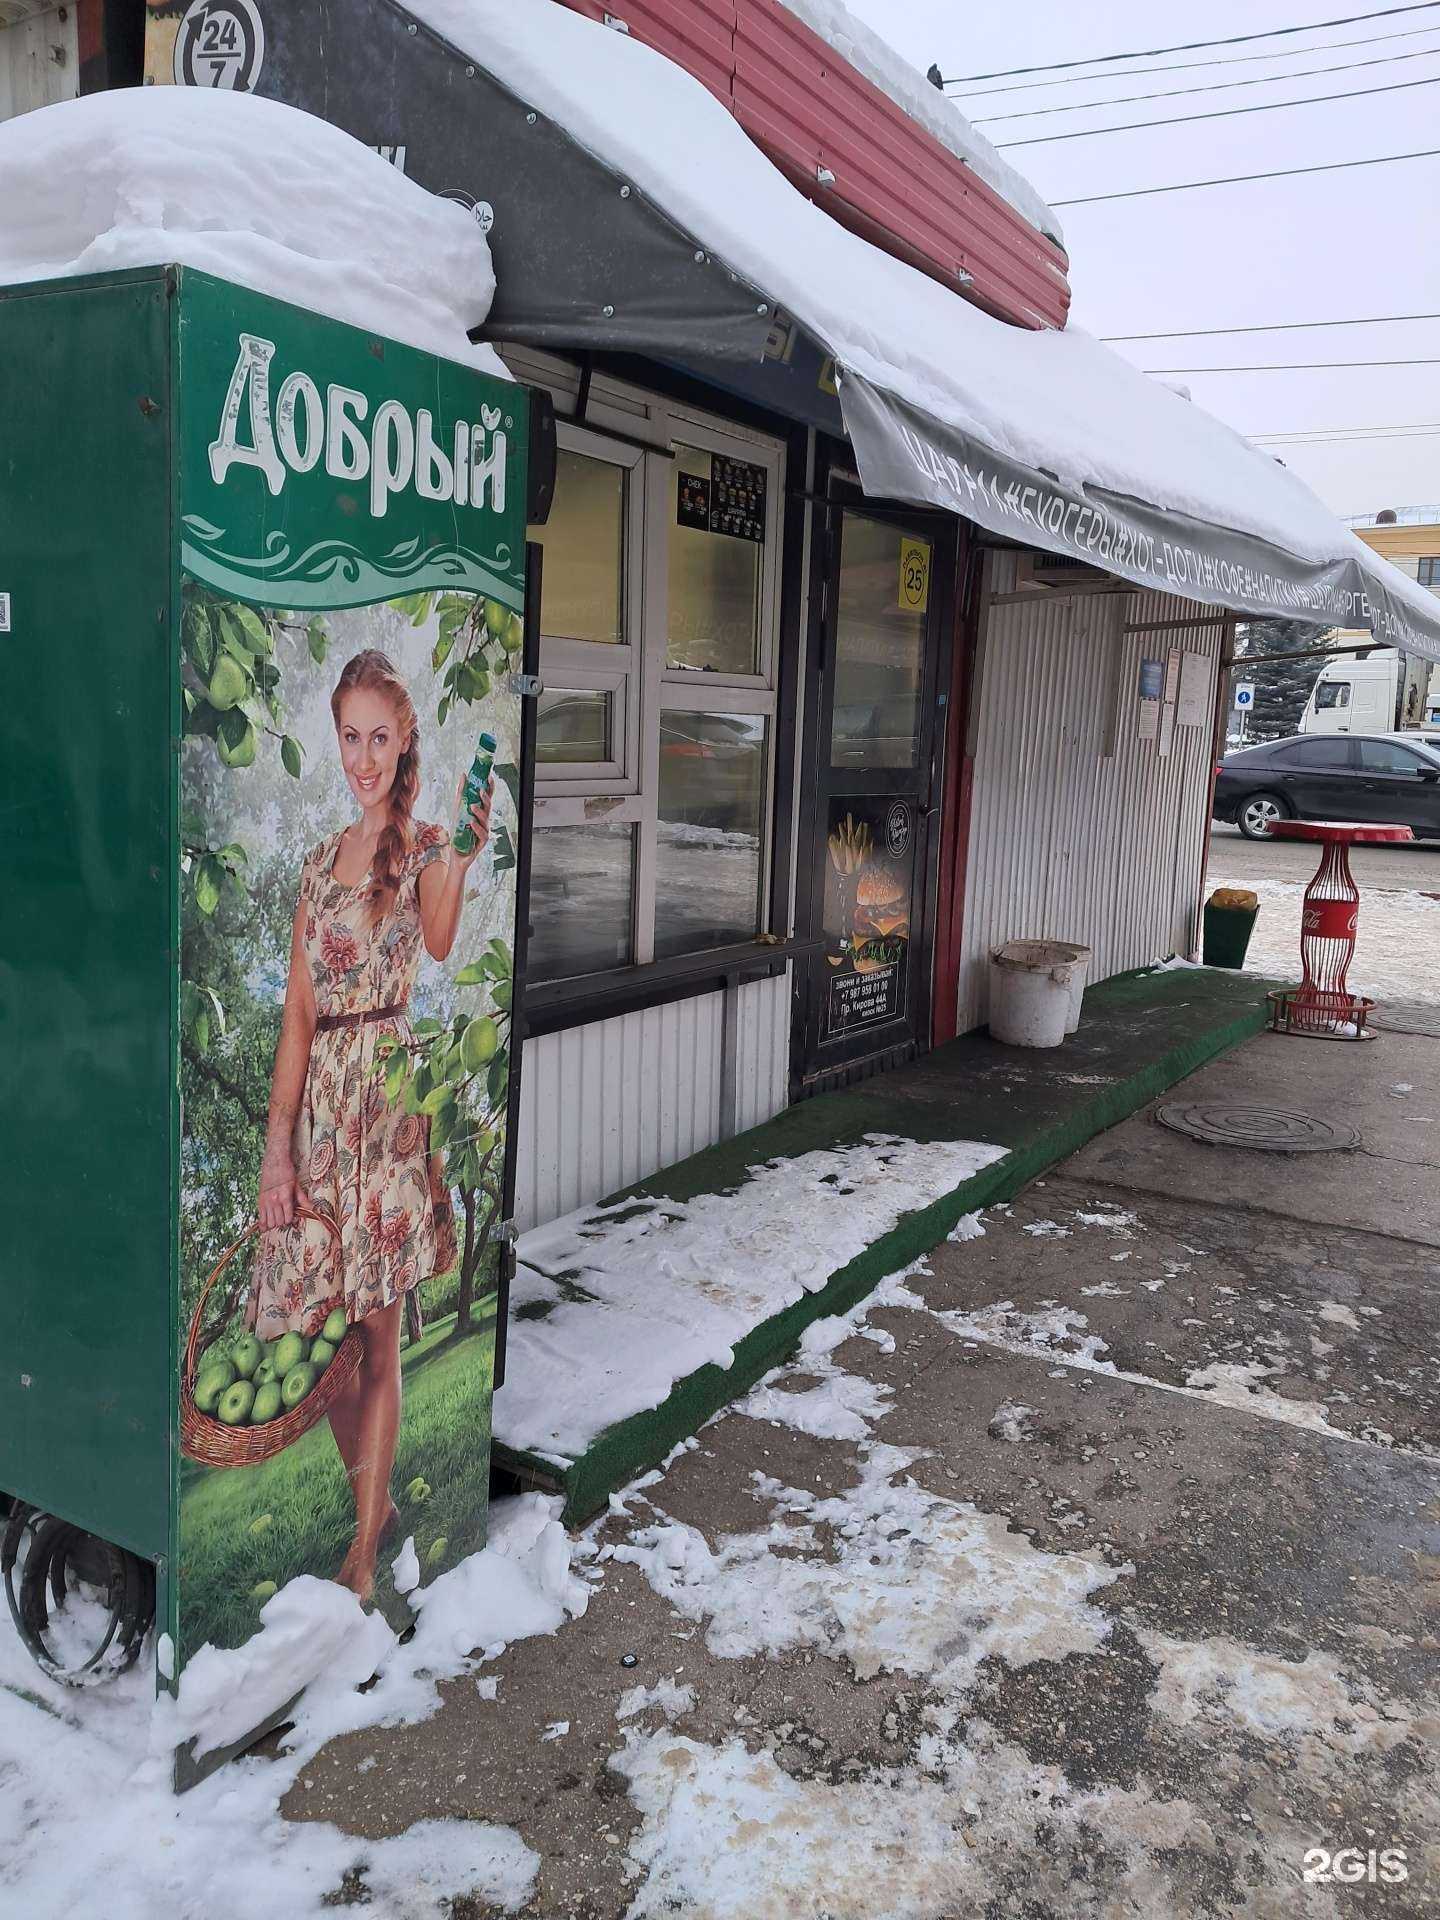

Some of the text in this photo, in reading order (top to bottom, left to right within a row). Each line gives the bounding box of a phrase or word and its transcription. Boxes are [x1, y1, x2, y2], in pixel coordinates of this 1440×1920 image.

[203, 19, 237, 51] 24
[210, 60, 226, 88] 7
[208, 332, 507, 518] Добрый
[906, 567, 922, 592] 25
[852, 998, 875, 1011] Кирова
